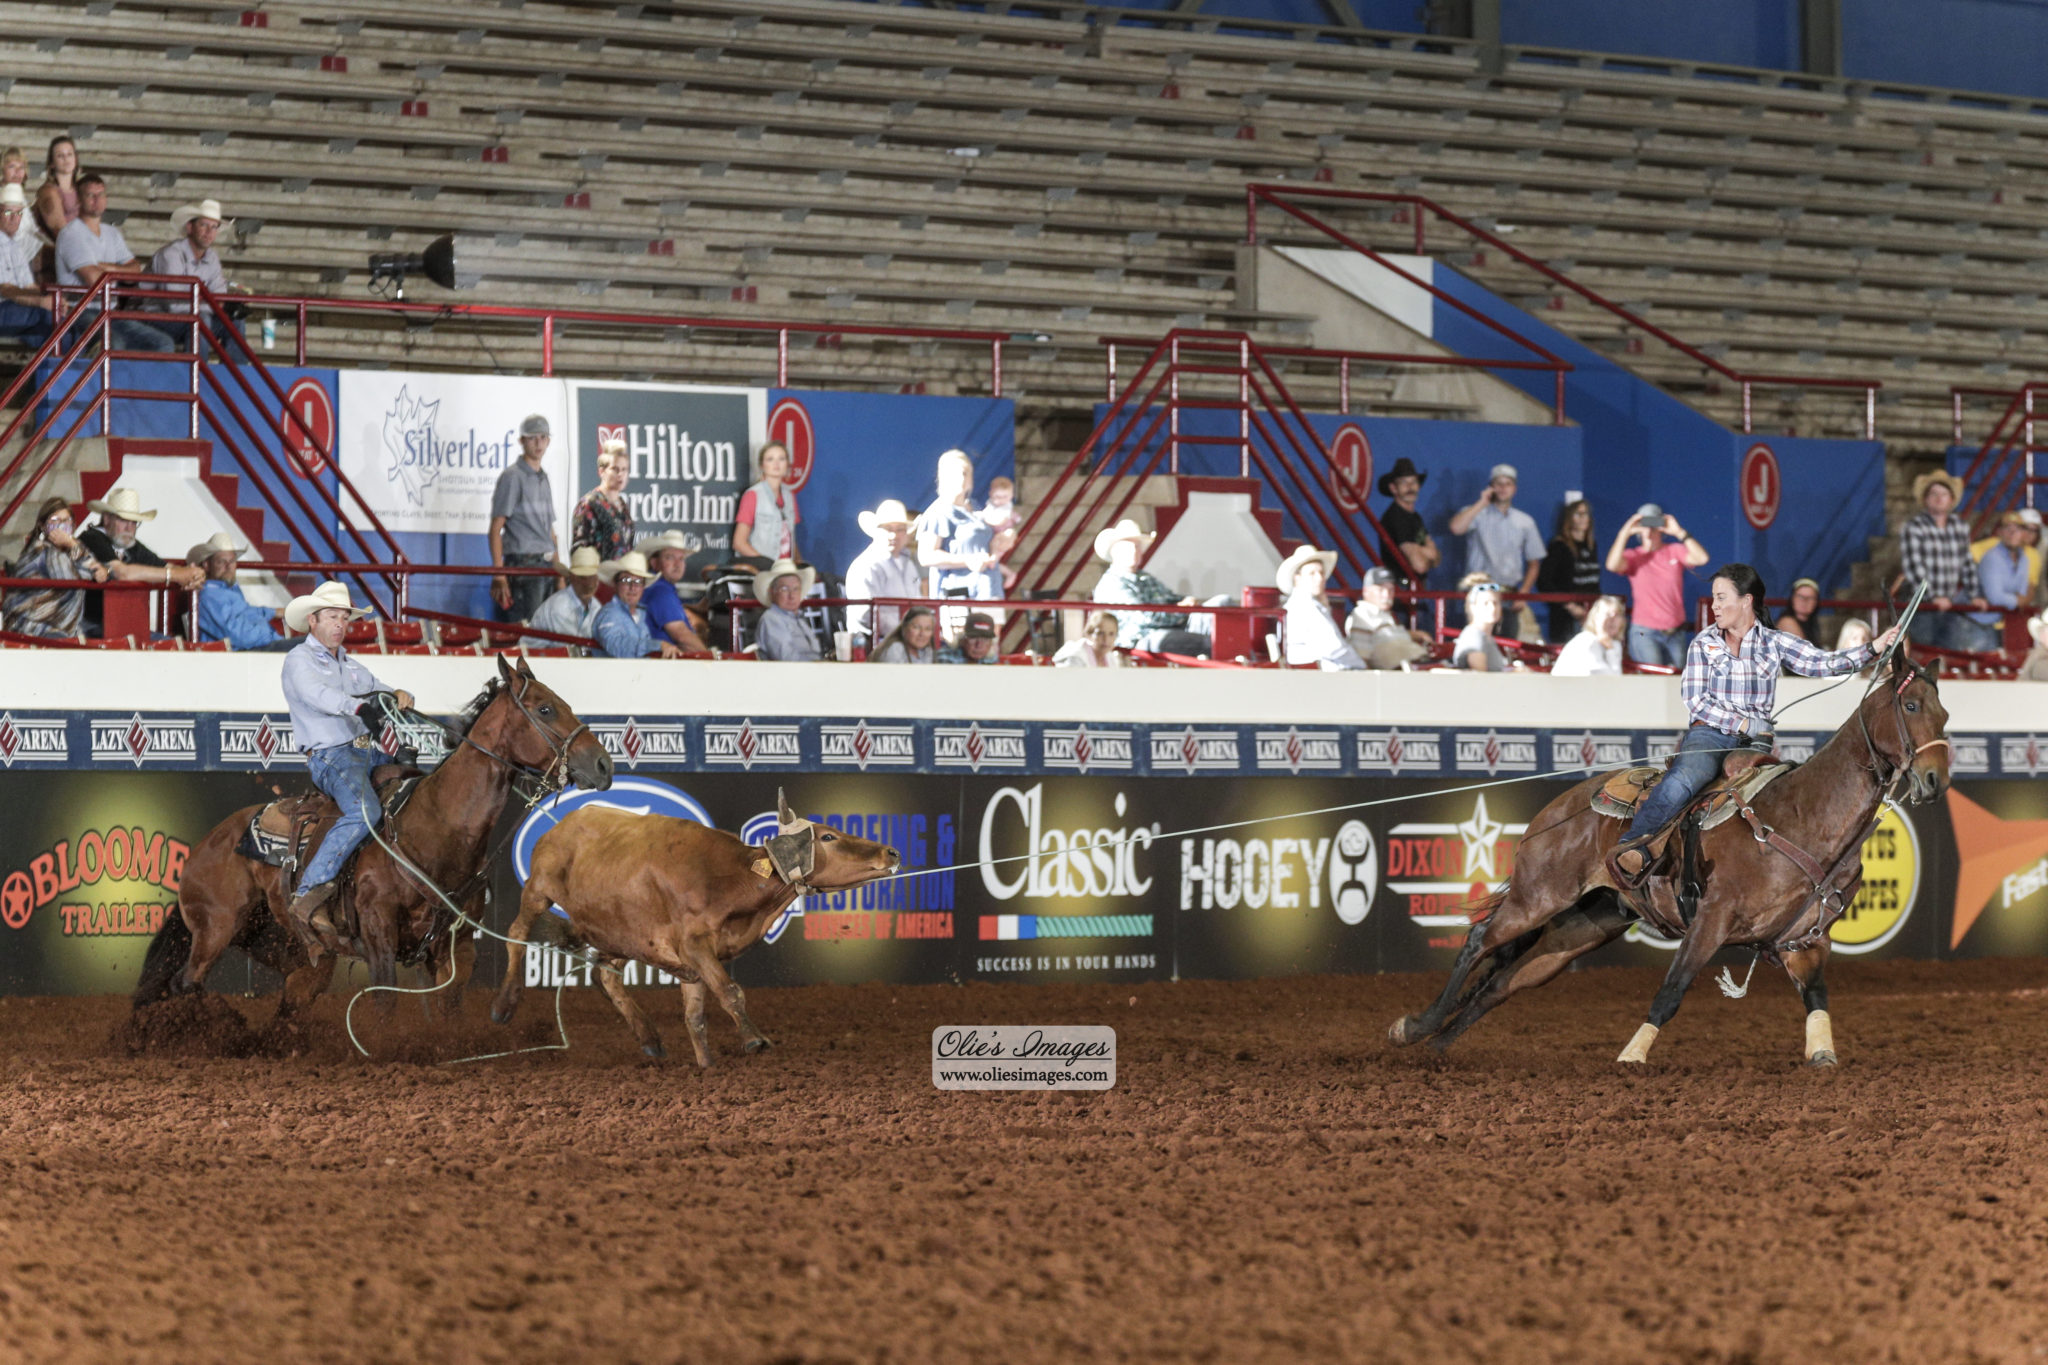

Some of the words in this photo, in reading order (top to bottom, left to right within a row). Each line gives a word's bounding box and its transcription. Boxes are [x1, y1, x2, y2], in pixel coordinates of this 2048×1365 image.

[403, 426, 514, 469] Silverleaf
[628, 423, 736, 482] Hilton
[1753, 463, 1769, 503] J
[618, 483, 690, 524] rden
[692, 485, 736, 524] Inn
[704, 533, 729, 549] North
[22, 729, 68, 751] ARENA
[91, 729, 125, 751] LAZY
[151, 729, 197, 751] ARENA
[220, 731, 254, 753] LAZY
[597, 734, 619, 753] AZY
[644, 734, 686, 753] ARENA
[705, 734, 735, 754] LAZY
[759, 734, 800, 754] ARENA
[821, 735, 851, 755] LAZY
[874, 735, 914, 755] ARENA
[934, 736, 963, 756] LAZY
[986, 737, 1025, 758] ARENA
[1044, 738, 1072, 758] LAZY
[1093, 740, 1132, 760] ARENA
[1151, 741, 1180, 760] LAZY
[1201, 741, 1239, 760] ARENA
[1256, 741, 1284, 760] LAZY
[1357, 741, 1385, 761] LAZY
[936, 814, 955, 867] &
[979, 782, 1153, 900] Classic
[29, 828, 190, 908] BLOOME
[1387, 837, 1464, 877] DIXON
[1180, 837, 1331, 911] HOOEY
[803, 914, 871, 940] SERVICES
[875, 913, 892, 940] OF
[895, 912, 954, 940] AMERICA
[977, 957, 1033, 972] SUCCESS
[1037, 957, 1050, 970] IS
[1056, 957, 1070, 970] IN
[1076, 956, 1110, 970] YOUR
[1114, 955, 1156, 969] HANDS
